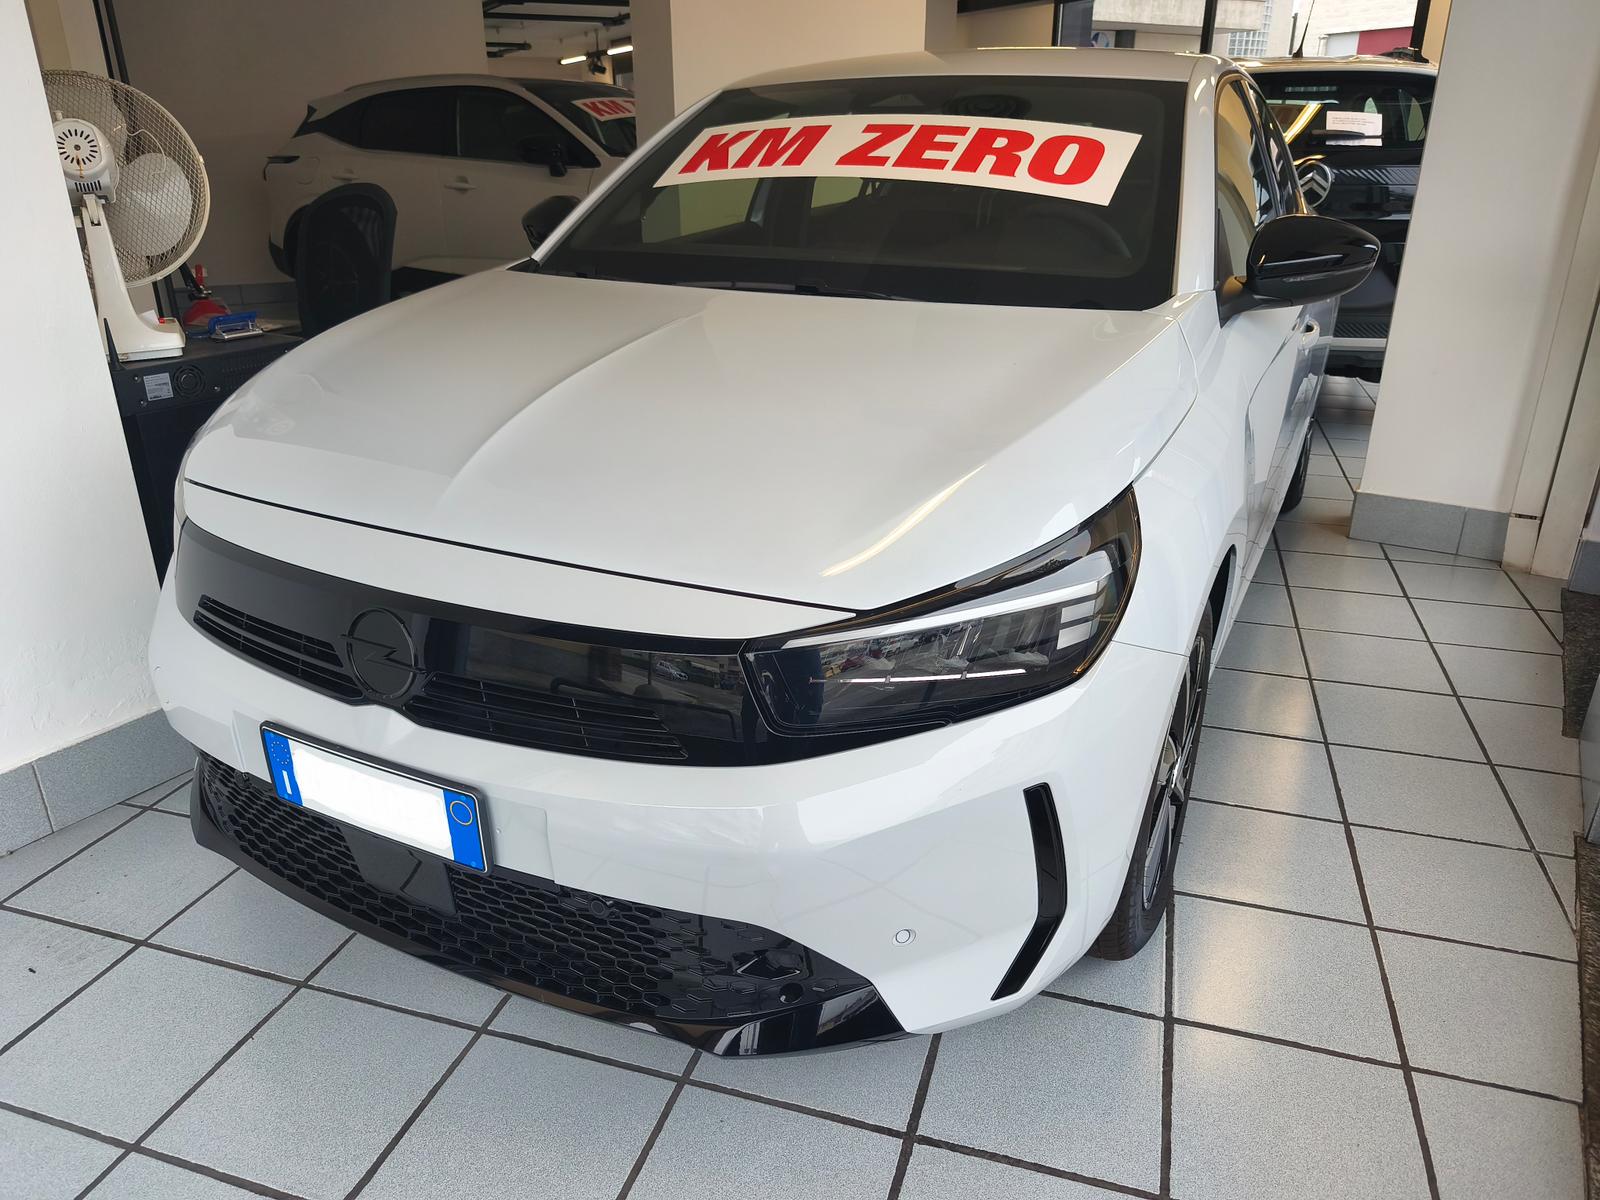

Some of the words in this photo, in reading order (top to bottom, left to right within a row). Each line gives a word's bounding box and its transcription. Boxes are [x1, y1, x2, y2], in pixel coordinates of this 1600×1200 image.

[583, 100, 632, 117] KM
[679, 124, 833, 175] KM
[836, 123, 1106, 186] ZERO
[282, 770, 293, 795] I
